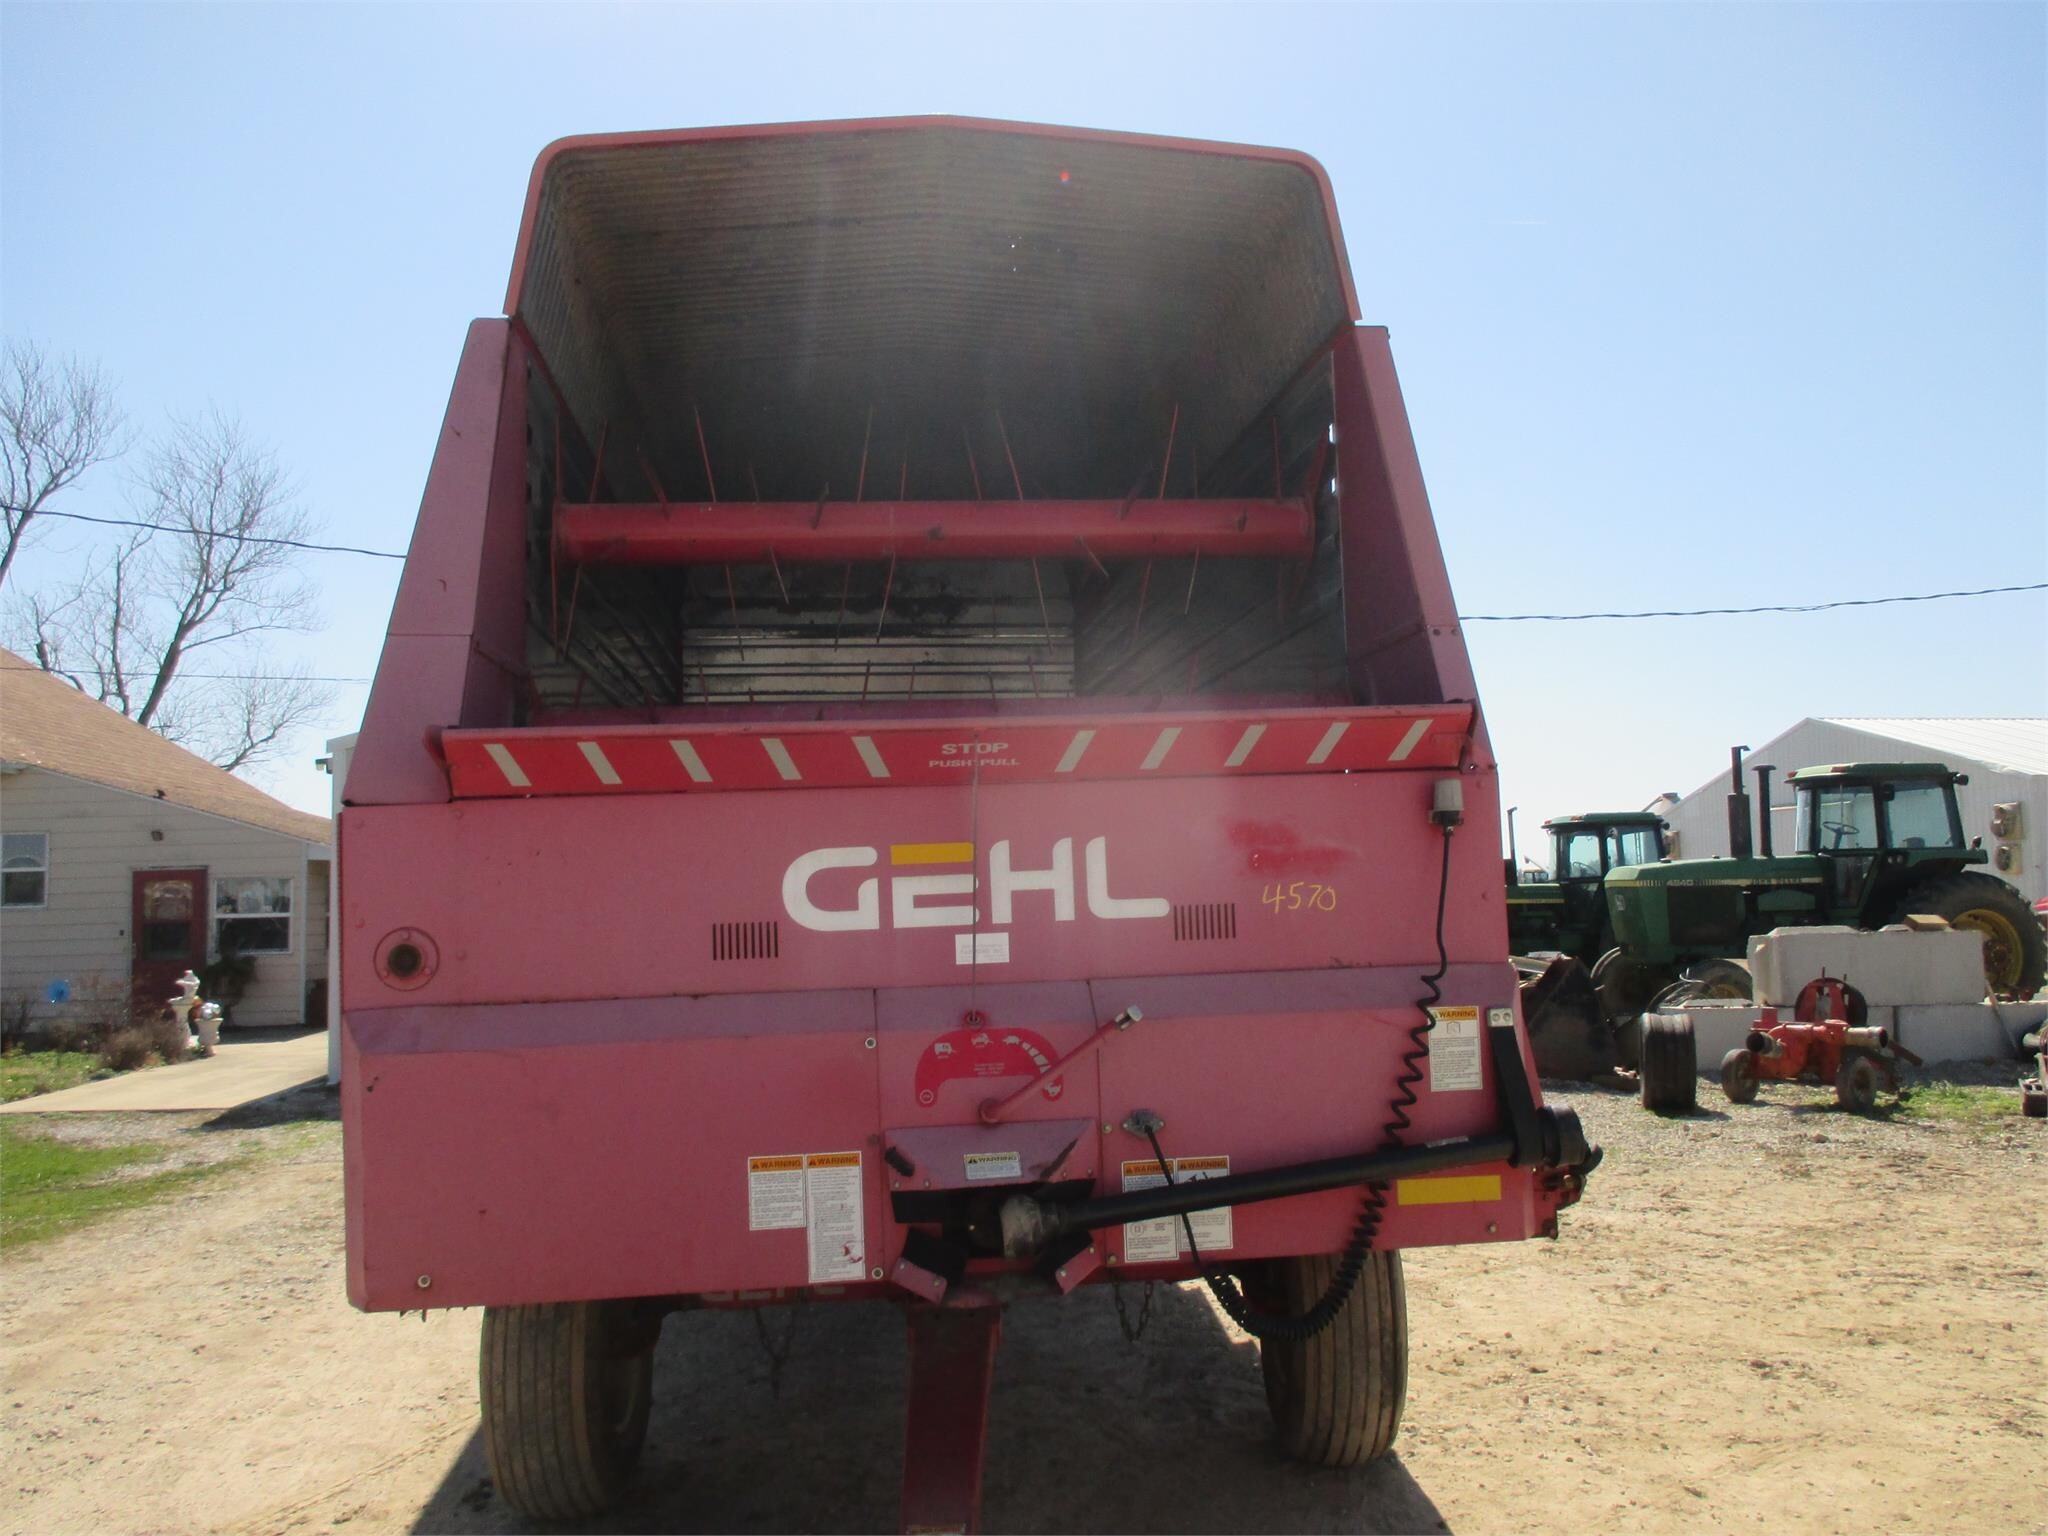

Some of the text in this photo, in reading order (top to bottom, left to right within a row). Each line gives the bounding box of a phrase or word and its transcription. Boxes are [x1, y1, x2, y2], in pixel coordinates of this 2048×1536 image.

[941, 743, 1009, 755] STOP
[928, 758, 1020, 768] PUSH PULL
[782, 836, 1170, 932] GEHL
[1262, 881, 1336, 914] 4570
[1440, 1009, 1477, 1019] WARNING
[760, 1159, 801, 1169] WARNING
[816, 1156, 859, 1165] WARNING
[978, 1155, 1018, 1163] WARNING
[1187, 1159, 1227, 1169] WARNING
